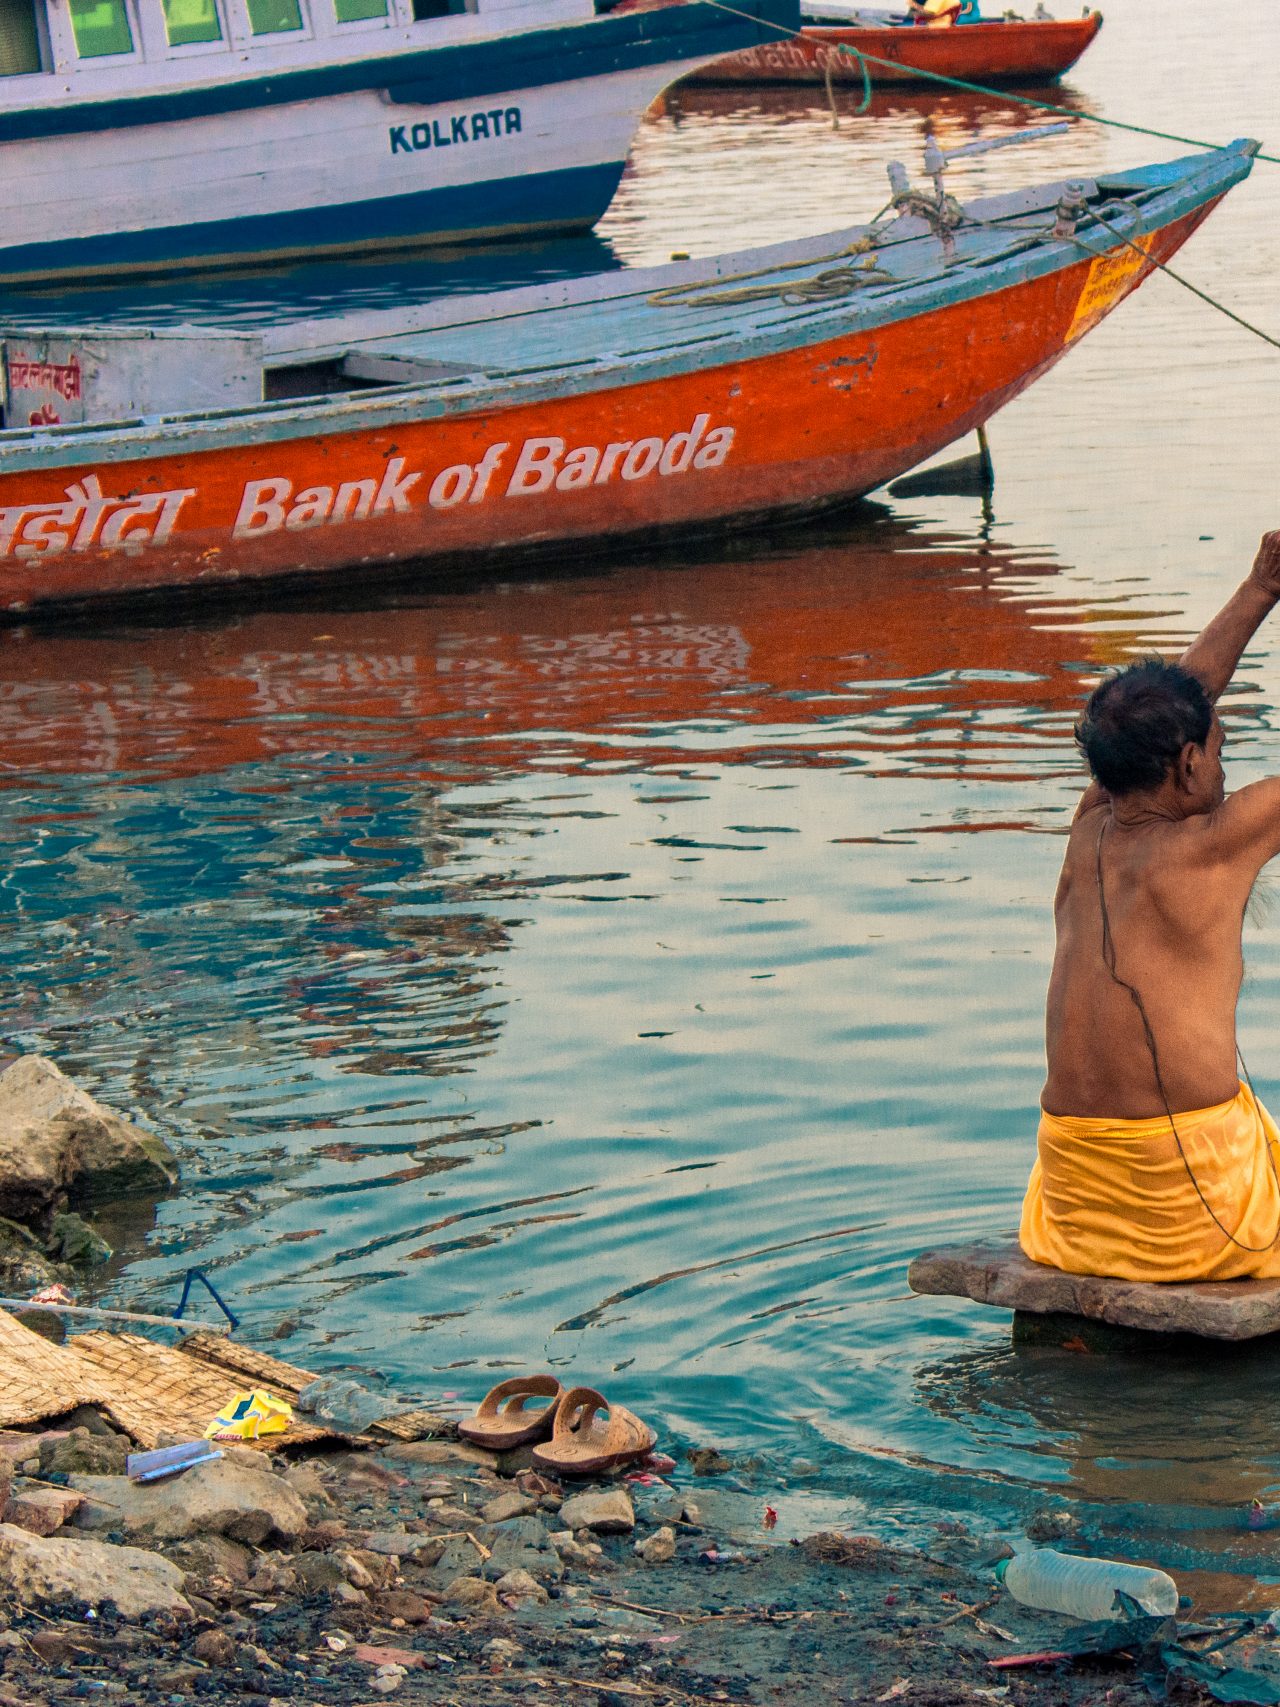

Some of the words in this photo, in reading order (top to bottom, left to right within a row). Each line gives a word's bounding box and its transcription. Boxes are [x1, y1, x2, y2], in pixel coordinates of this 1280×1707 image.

[389, 107, 522, 154] KOLKATA
[231, 456, 424, 540] Bank
[428, 442, 510, 509] of
[505, 413, 736, 497] Baroda
